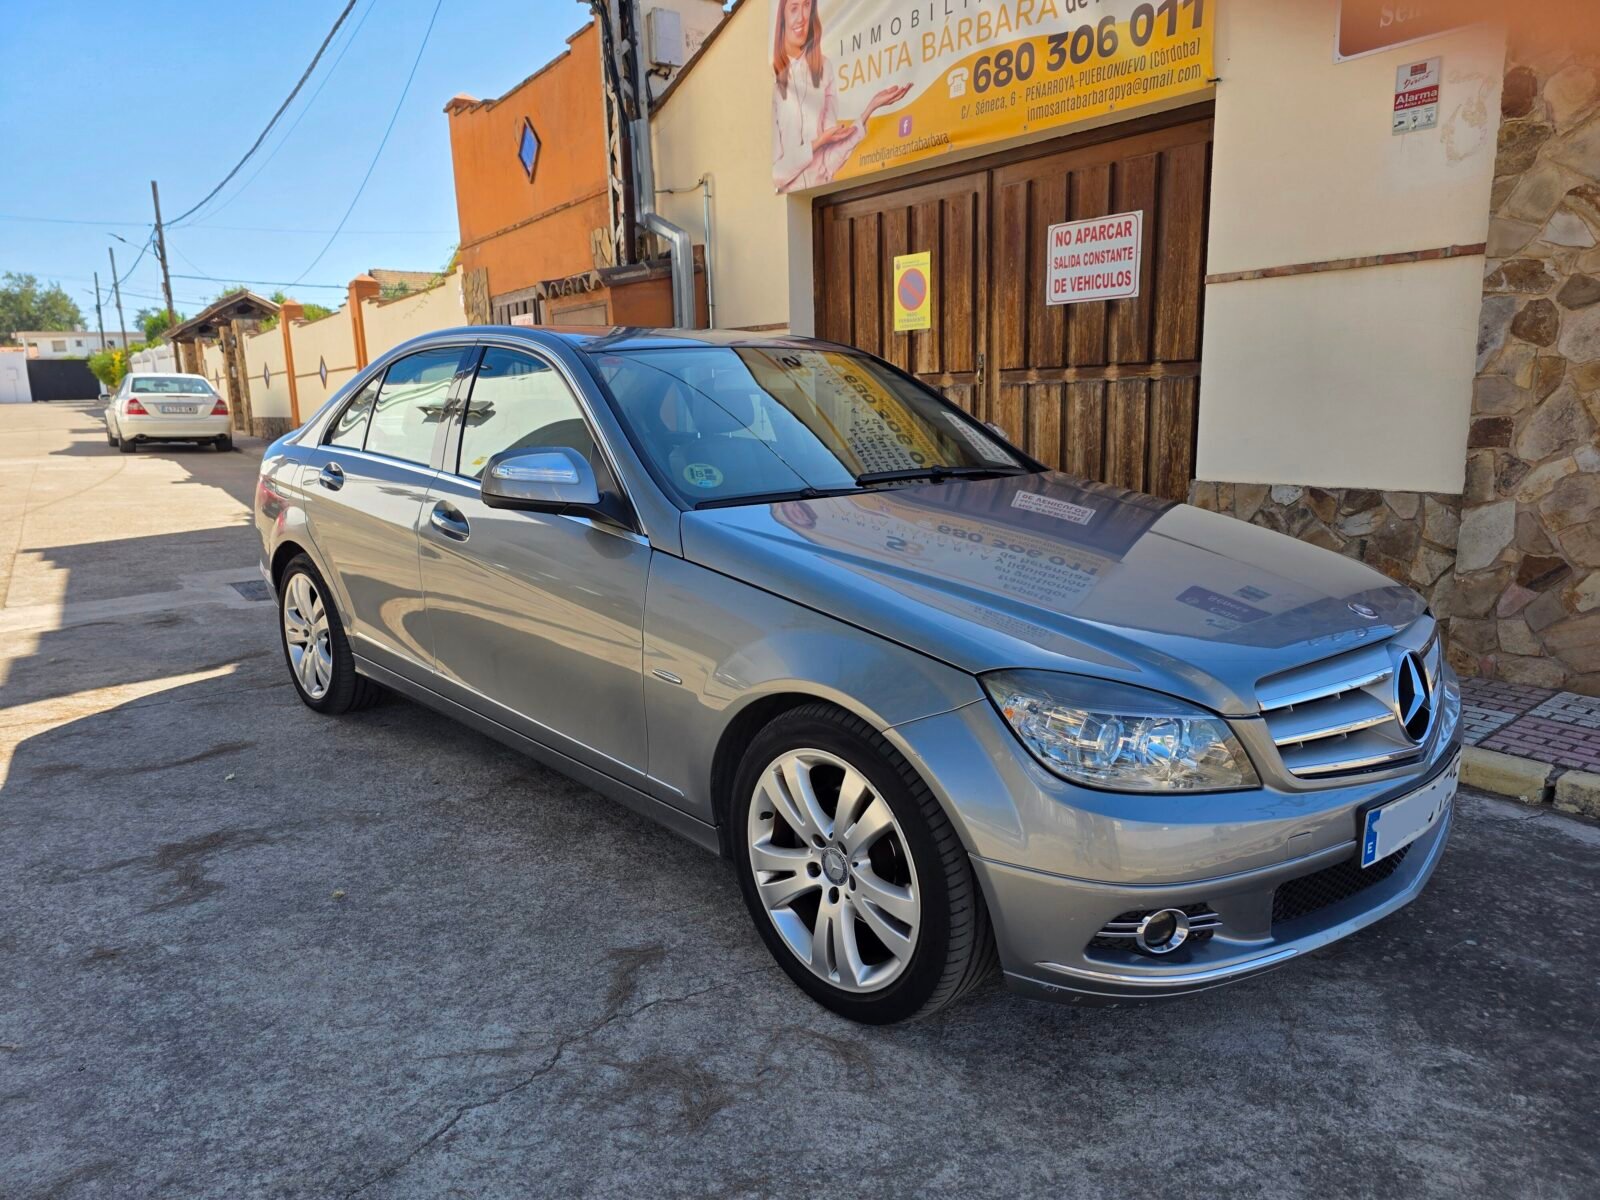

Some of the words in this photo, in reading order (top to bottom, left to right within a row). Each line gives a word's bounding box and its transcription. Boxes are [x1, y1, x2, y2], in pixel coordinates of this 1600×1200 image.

[838, 40, 912, 92] SANTA
[921, 0, 1058, 63] BÁRBARA
[973, 42, 1035, 93] 680
[1046, 15, 1119, 72] 306
[1129, 0, 1204, 47] 011
[975, 94, 1008, 116] Séneca,
[1010, 91, 1016, 106] 6
[1025, 55, 1146, 102] PEÑARROYA-PUEBLONUEVO
[1026, 64, 1201, 122] inmosantabarbarapya@gmail.com
[1396, 89, 1438, 105] Alarma
[1055, 230, 1072, 247] NO
[1075, 220, 1132, 245] APARCAR
[1053, 254, 1081, 270] SALIDA
[1083, 246, 1133, 266] CONSTANTE
[1054, 278, 1067, 294] DE
[1070, 270, 1132, 292] VEHICULOS
[1367, 841, 1374, 855] E
